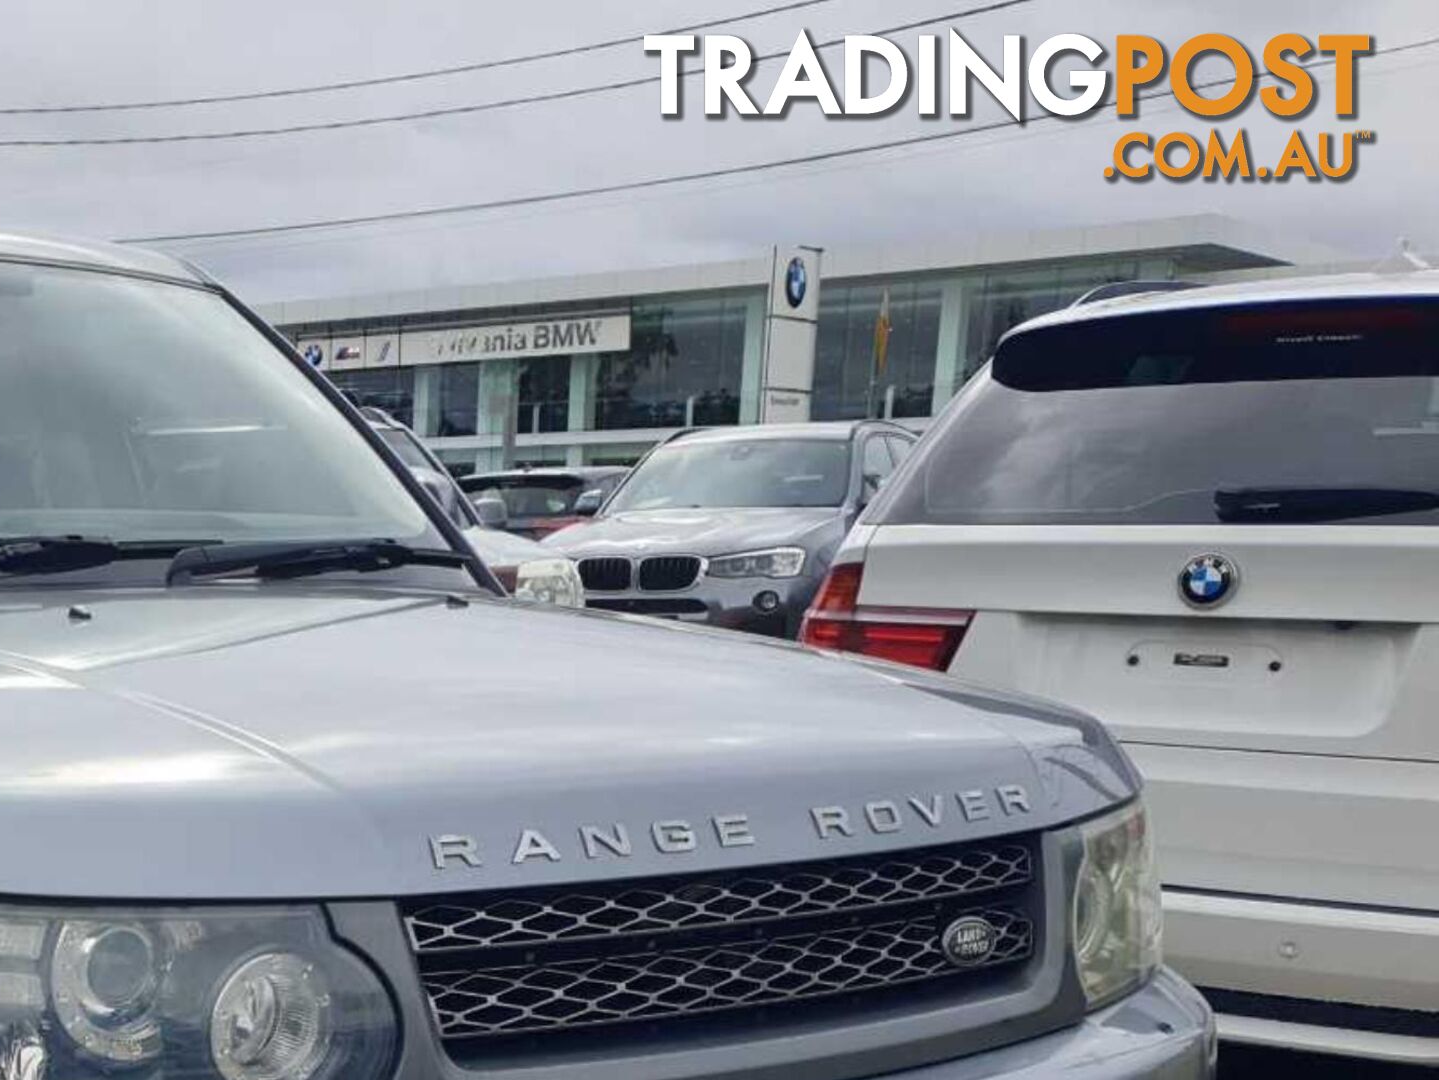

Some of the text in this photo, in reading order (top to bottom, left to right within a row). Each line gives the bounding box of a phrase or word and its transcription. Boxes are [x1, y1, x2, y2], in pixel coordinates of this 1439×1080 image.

[533, 321, 603, 350] BMW
[427, 782, 1033, 869] RANGE ROVER
